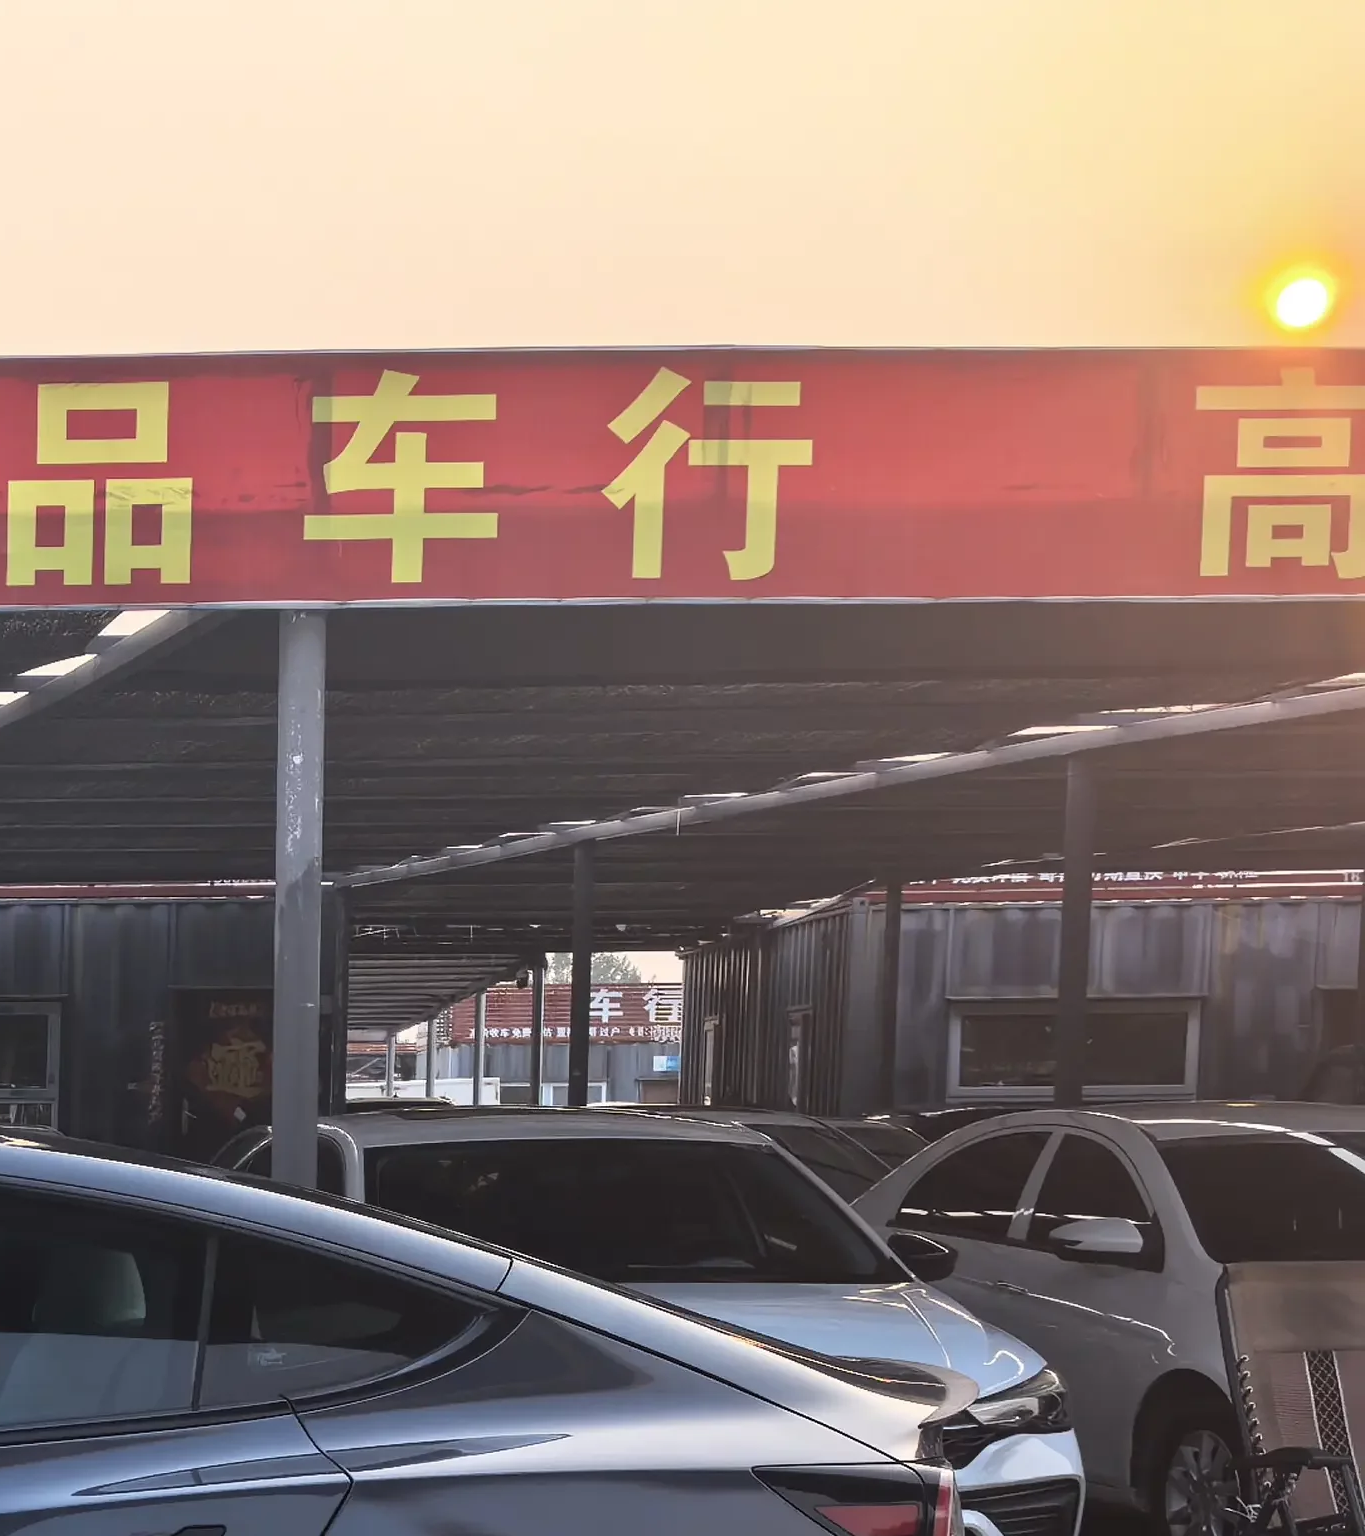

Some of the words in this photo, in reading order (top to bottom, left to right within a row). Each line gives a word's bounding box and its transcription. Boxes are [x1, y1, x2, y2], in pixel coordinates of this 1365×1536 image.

[1196, 367, 1365, 579] 高
[512, 1027, 552, 1038] 免费估
